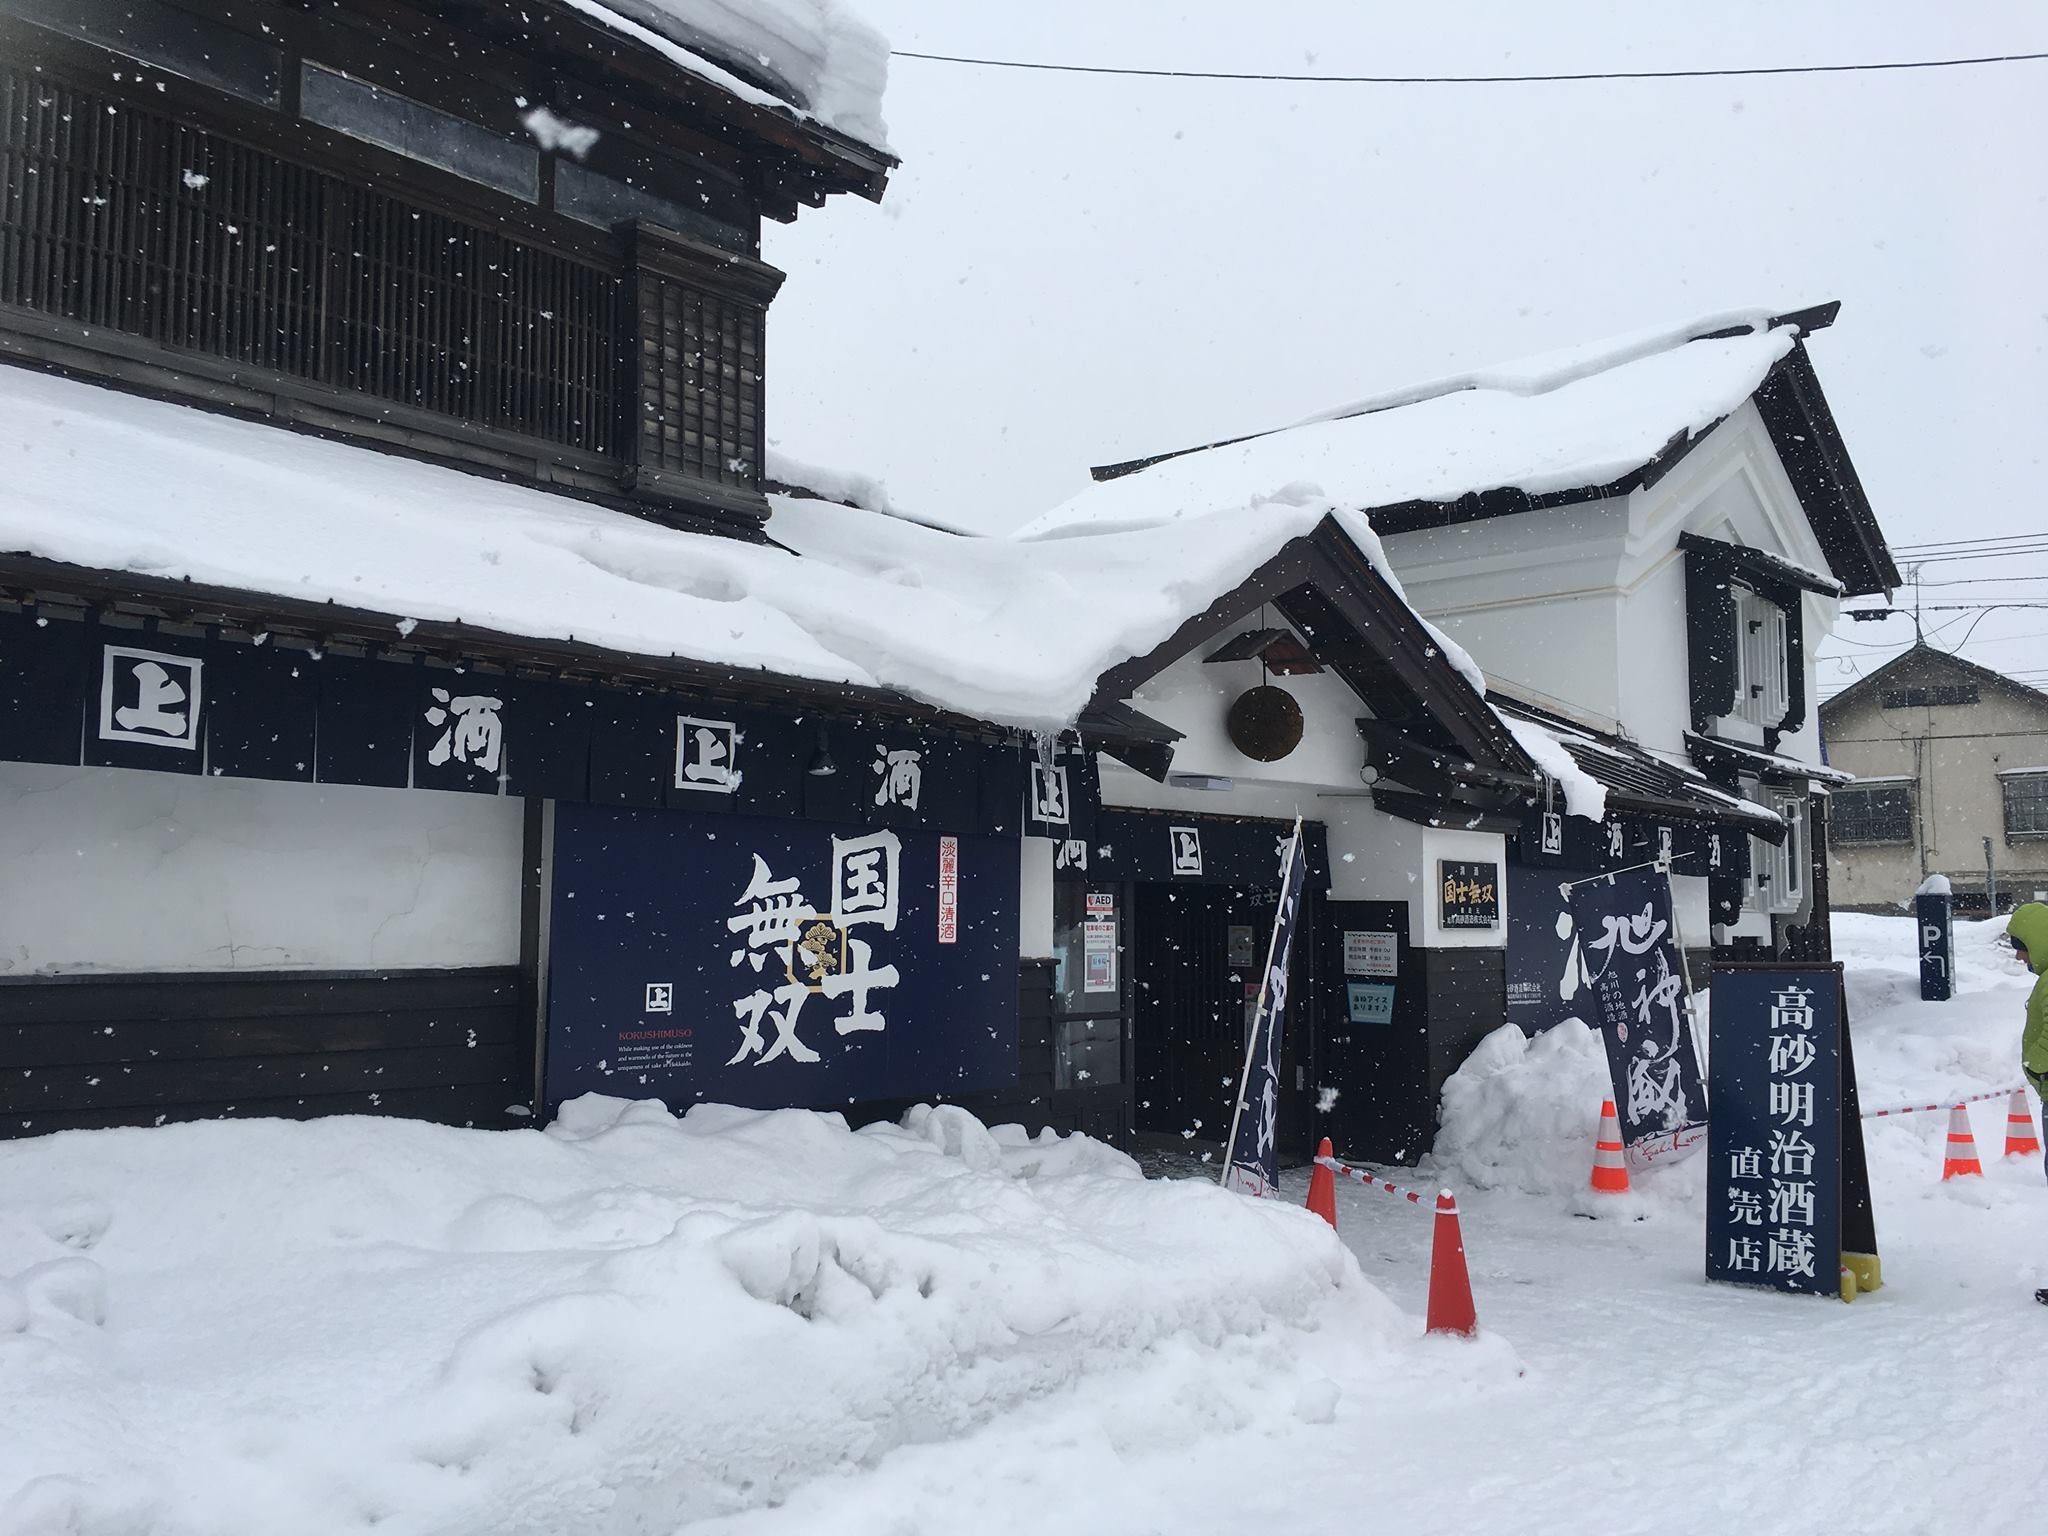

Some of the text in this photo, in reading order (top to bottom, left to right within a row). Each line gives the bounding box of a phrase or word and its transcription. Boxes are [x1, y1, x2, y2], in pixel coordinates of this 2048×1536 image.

[115, 661, 187, 737] 上
[424, 687, 503, 772] 酒
[685, 727, 728, 784] 上
[872, 743, 923, 811] 酒
[1040, 770, 1063, 817] 上
[1177, 832, 1200, 869] 上
[1606, 820, 1624, 860] 酒
[941, 840, 956, 939] 淡麗辛口清酒
[1095, 895, 1111, 905] AED
[1444, 878, 1495, 905] 国士無双
[725, 852, 822, 1068] 無双
[821, 829, 902, 1035] 国士
[1922, 925, 1942, 948] P
[649, 987, 669, 1009] 上
[618, 1029, 693, 1041] KOKUSHIMUSO
[1766, 985, 1816, 1278] 高砂明治酒蔵
[1727, 1146, 1763, 1272] 直売店
